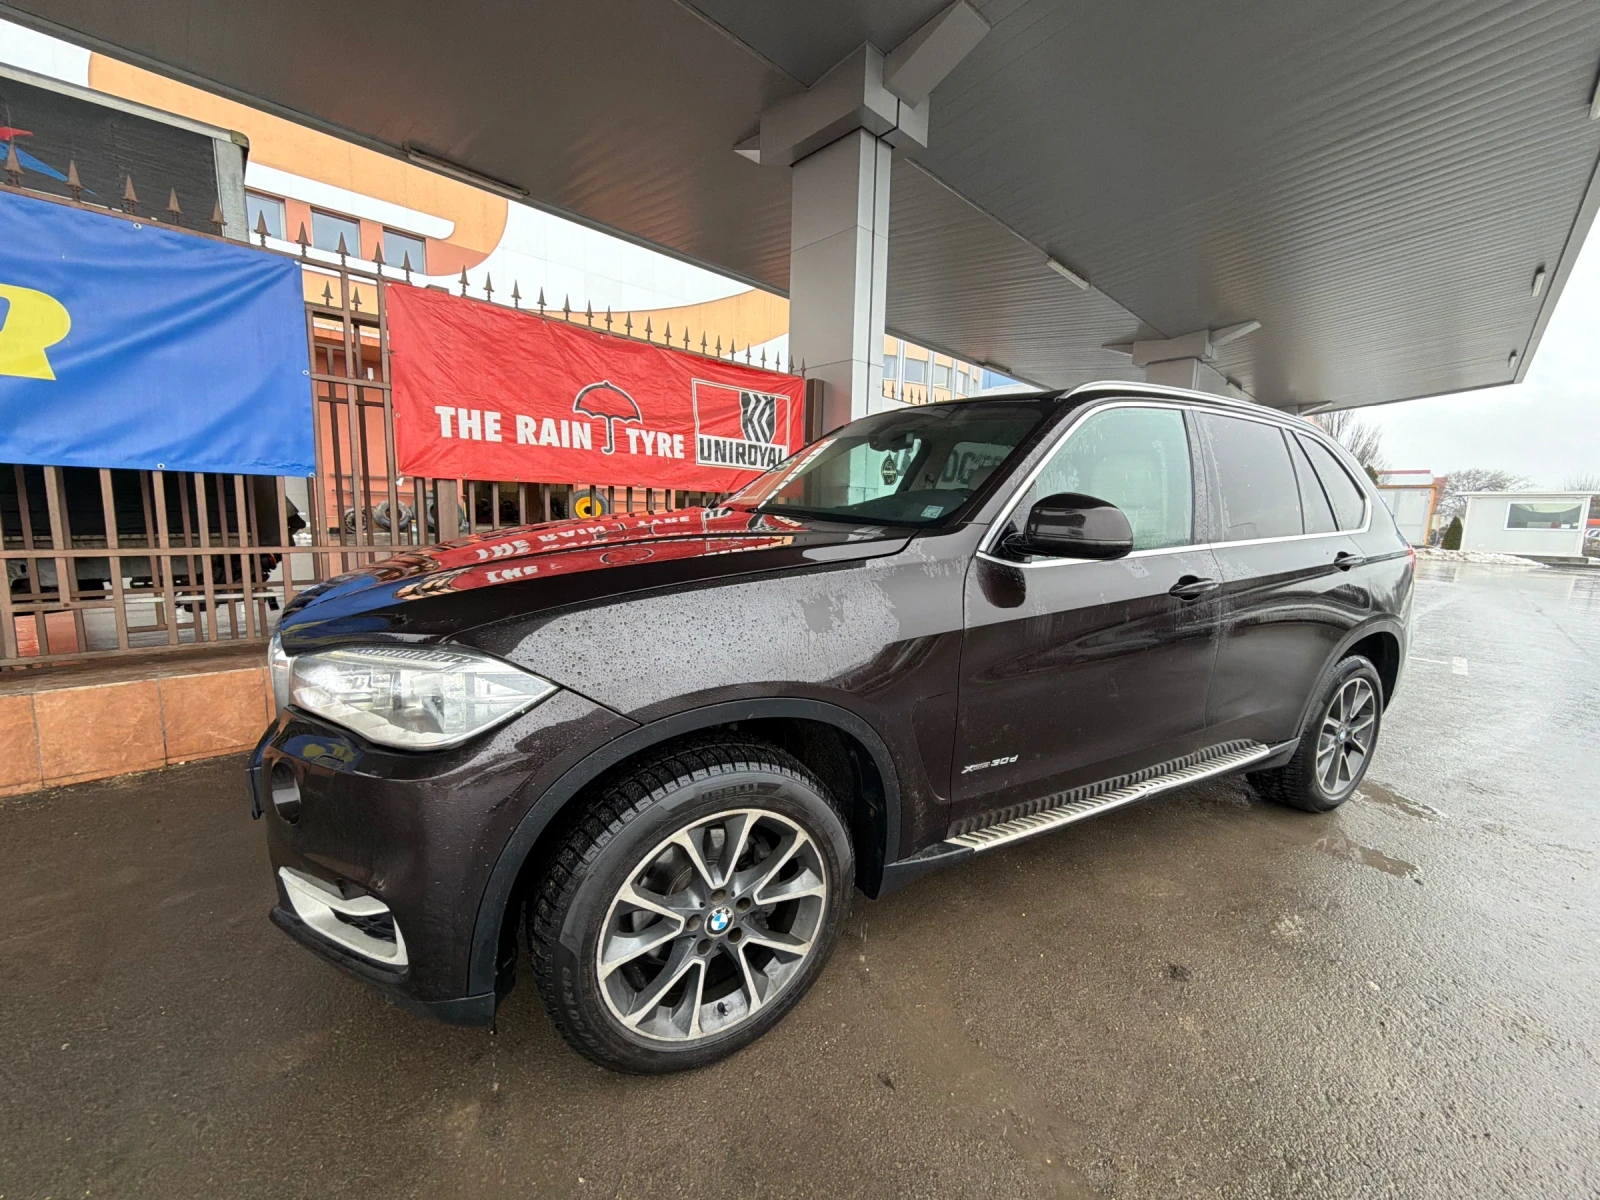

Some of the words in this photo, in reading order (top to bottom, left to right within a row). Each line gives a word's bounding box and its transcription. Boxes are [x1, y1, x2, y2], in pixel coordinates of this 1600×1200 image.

[434, 405, 502, 442] THE
[516, 415, 592, 451] RAIN
[626, 428, 685, 459] TYRE
